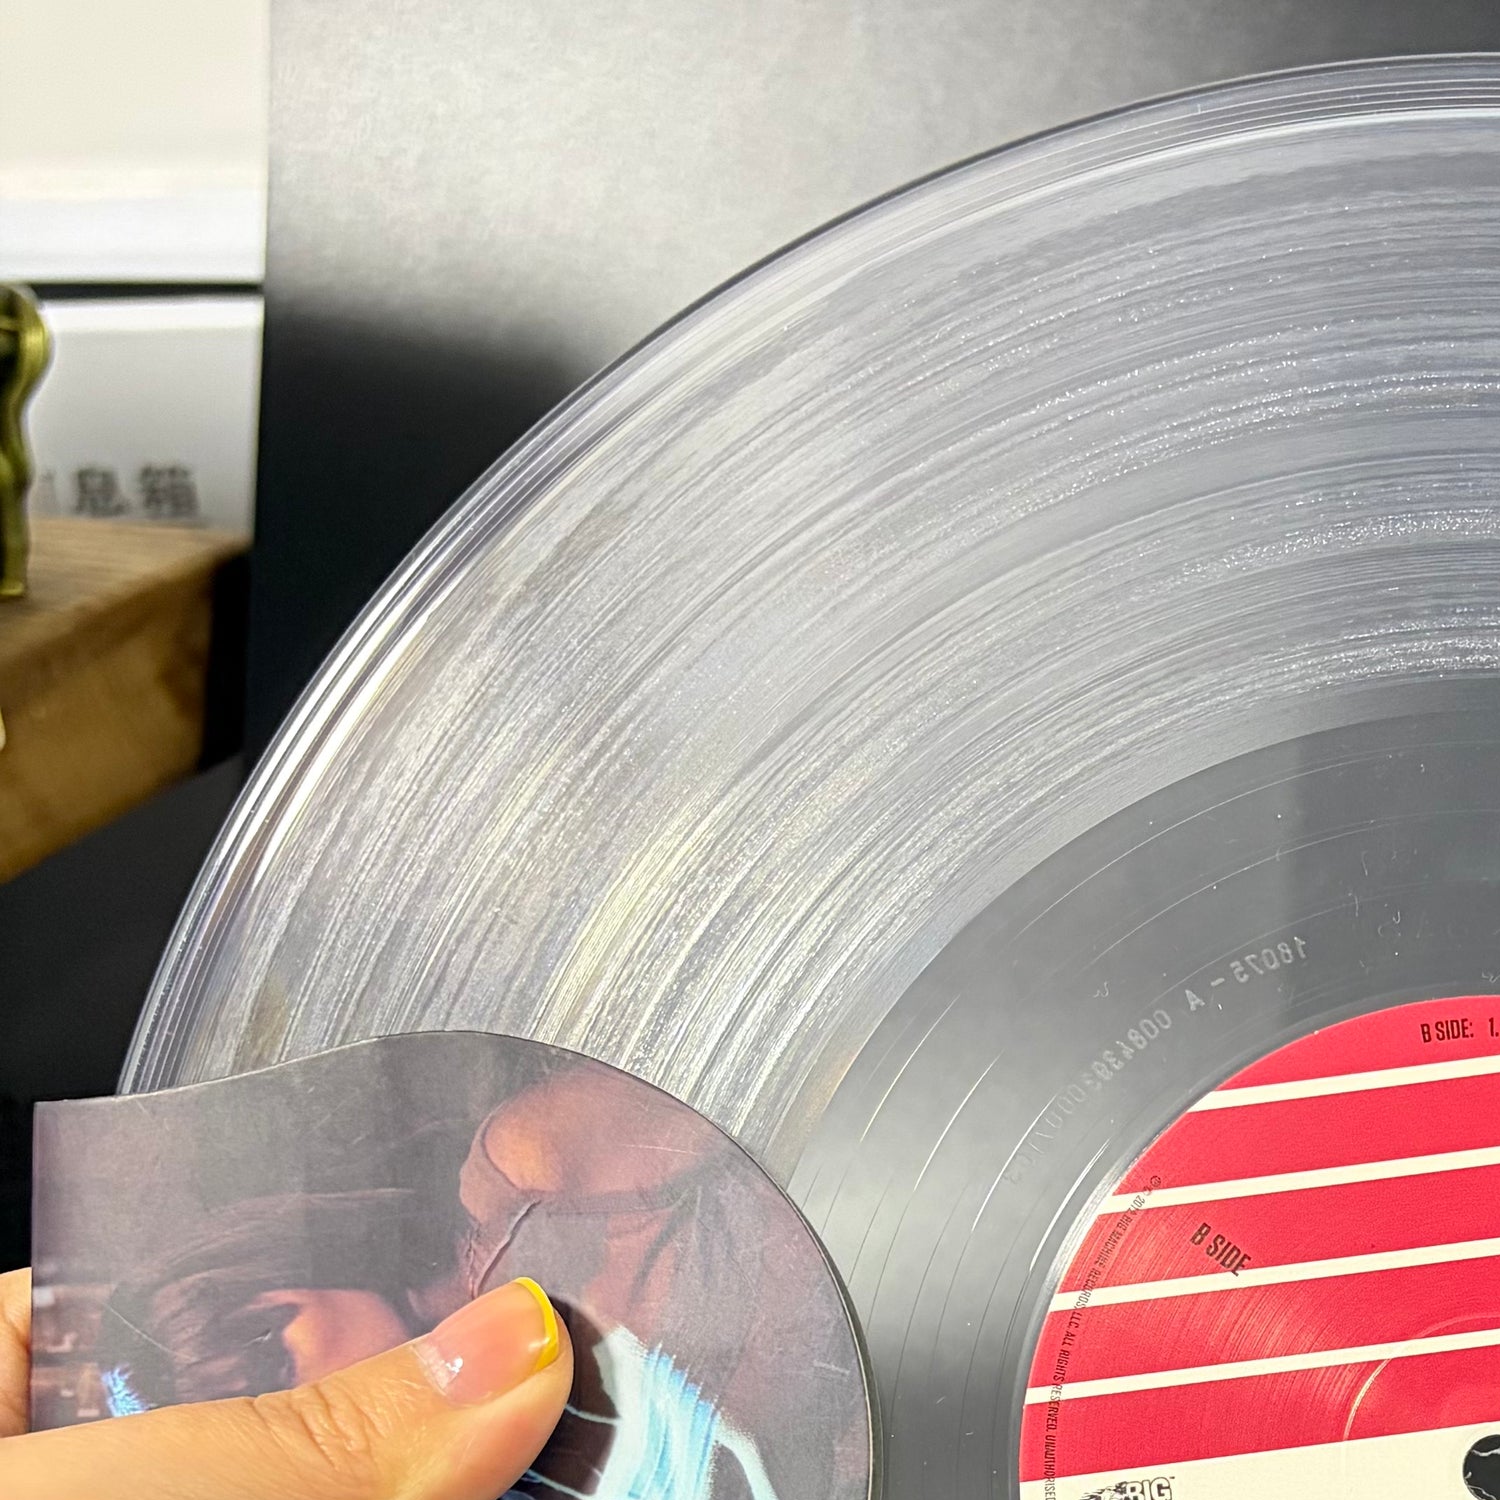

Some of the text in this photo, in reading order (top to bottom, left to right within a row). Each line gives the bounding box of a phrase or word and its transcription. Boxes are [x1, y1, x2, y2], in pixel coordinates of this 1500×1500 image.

[1419, 1016, 1474, 1043] B SIDE:
[1487, 1016, 1499, 1037] 1.
[1124, 1193, 1147, 1217] 2012
[1114, 1212, 1134, 1232] BIG
[1092, 1227, 1124, 1269] MACHINE
[1190, 1222, 1252, 1277] B SIDE
[1060, 1329, 1077, 1348] ALL
[1051, 1348, 1071, 1382] RIGHTS
[1044, 1382, 1064, 1433] RESERVED.
